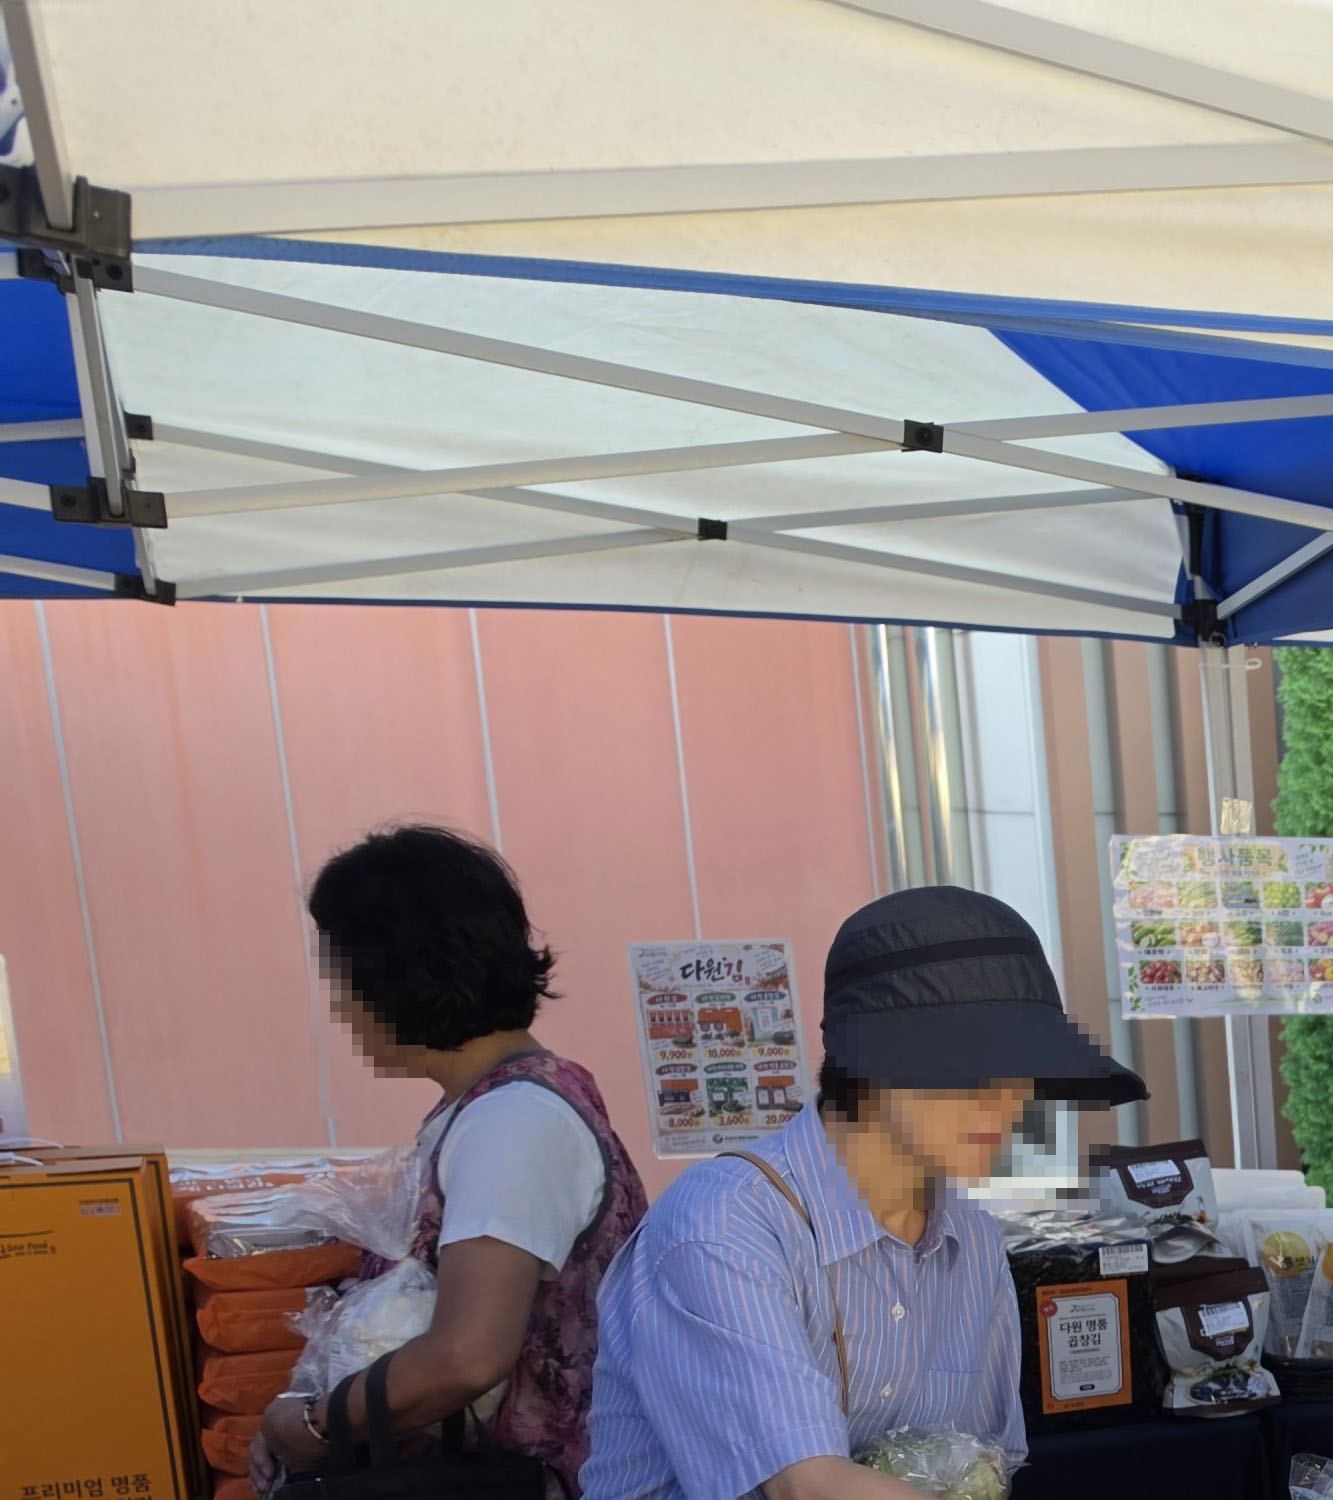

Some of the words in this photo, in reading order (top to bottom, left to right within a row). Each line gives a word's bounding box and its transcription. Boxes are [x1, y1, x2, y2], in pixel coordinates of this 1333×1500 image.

[679, 957, 744, 983] 다원김
[1060, 1319, 1083, 1334] 다원
[1086, 1318, 1108, 1332] 명품
[1067, 1332, 1102, 1348] 곱창김
[111, 1473, 152, 1496] 명품
